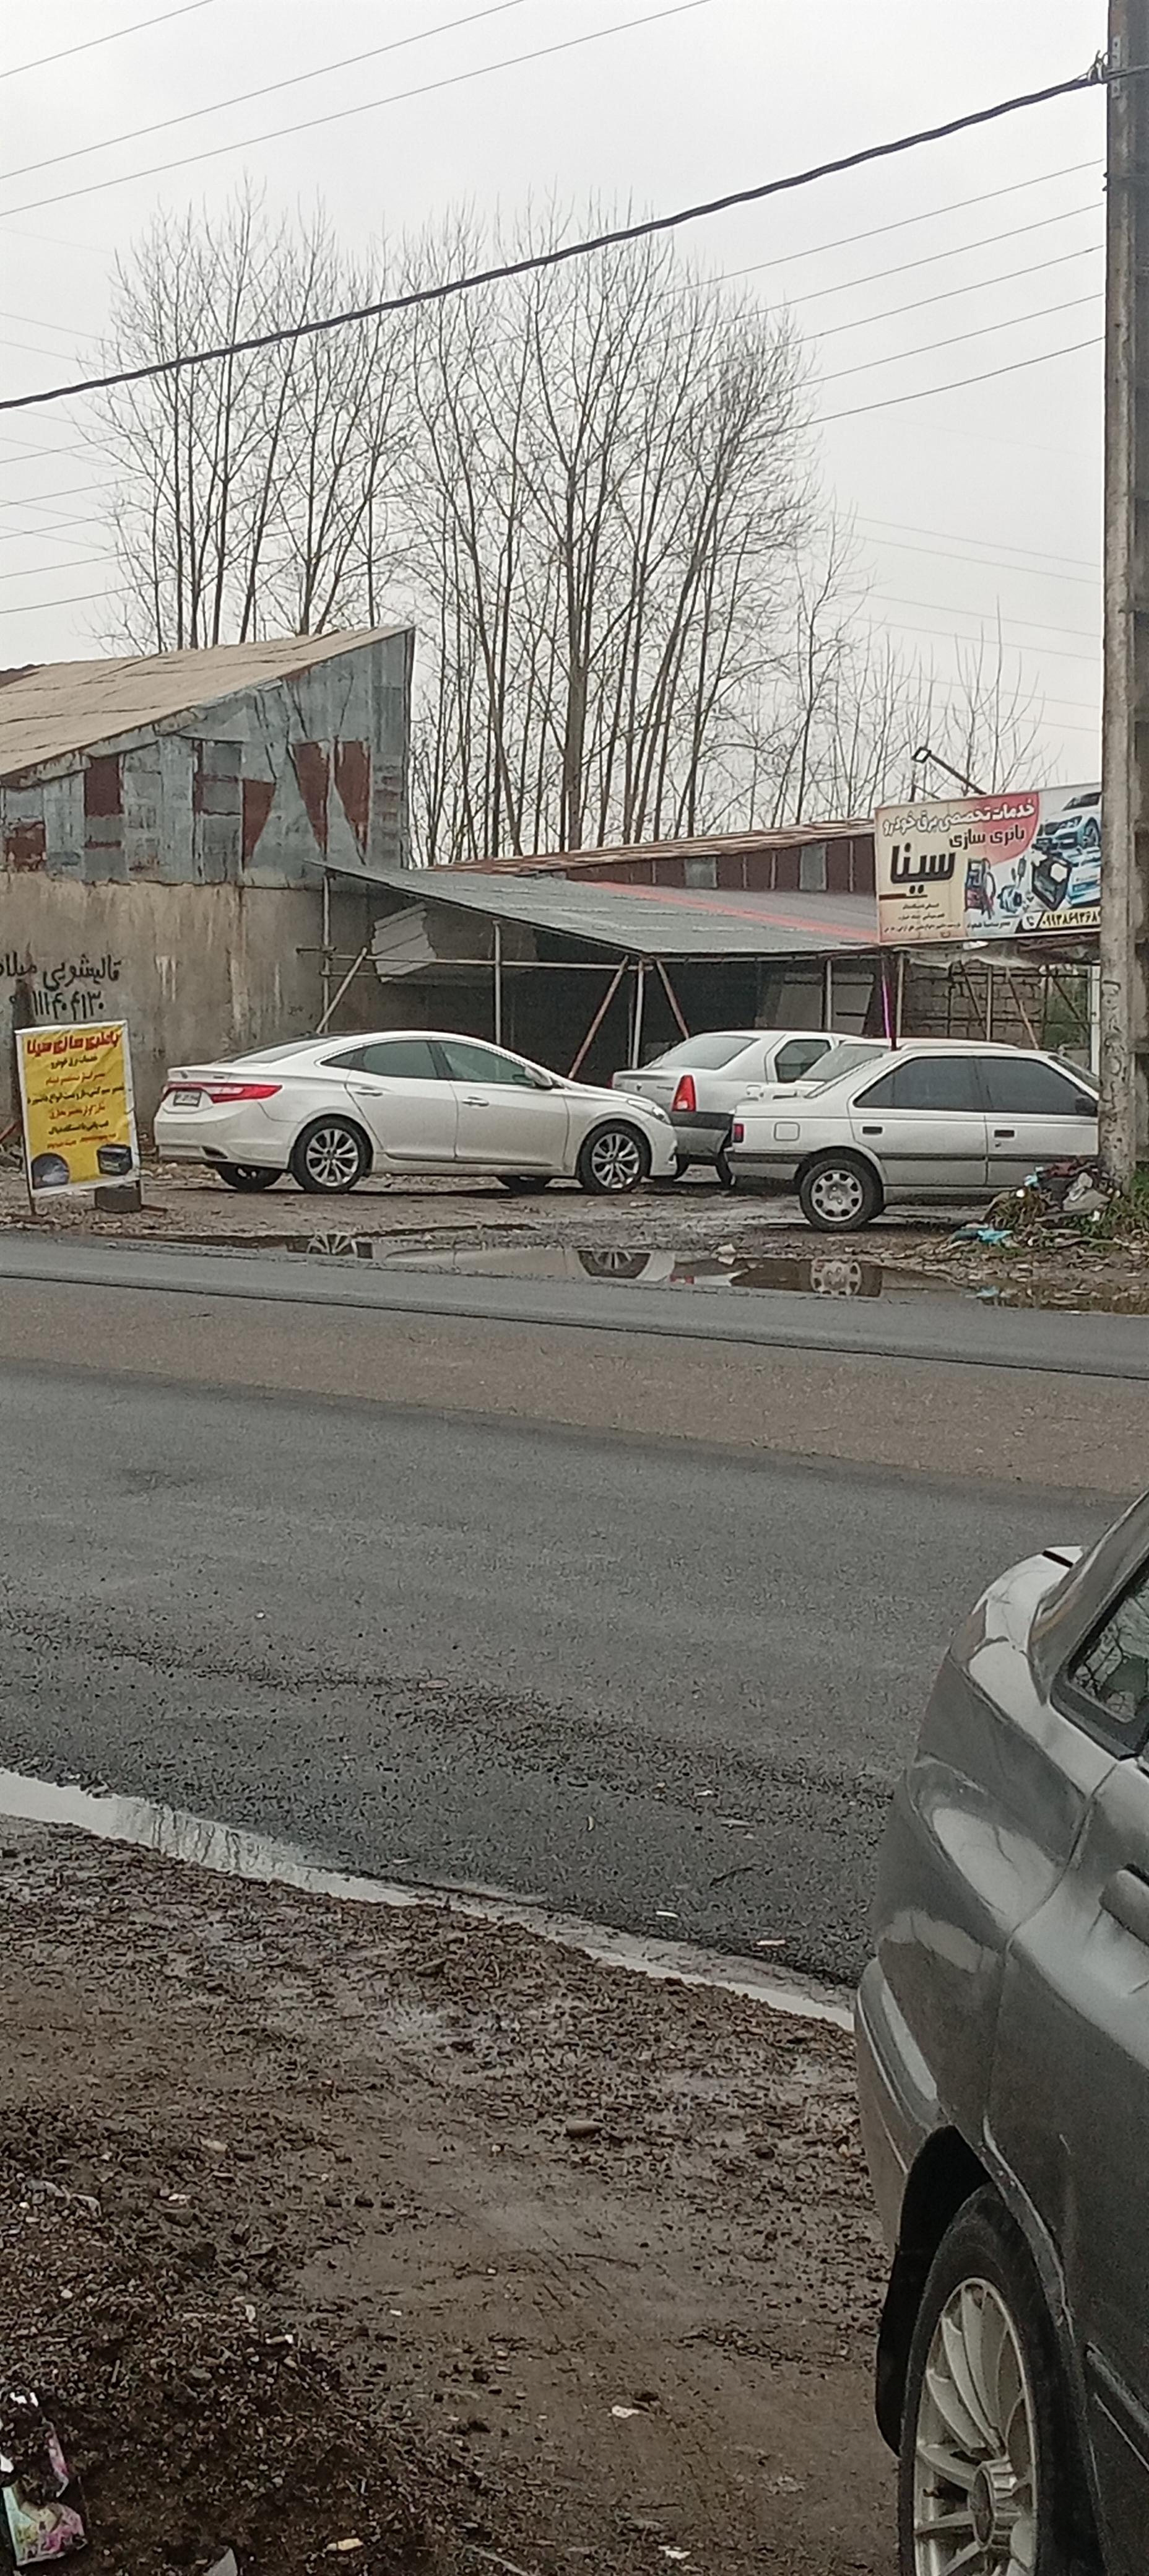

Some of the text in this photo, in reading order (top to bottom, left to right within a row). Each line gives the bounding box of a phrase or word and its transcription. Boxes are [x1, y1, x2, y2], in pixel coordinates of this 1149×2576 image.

[882, 798, 1035, 837] خدمات تخصصی برق خودرو
[949, 824, 1025, 850] باتری سازی
[890, 842, 956, 894] سینا
[27, 1038, 52, 1057] سینا
